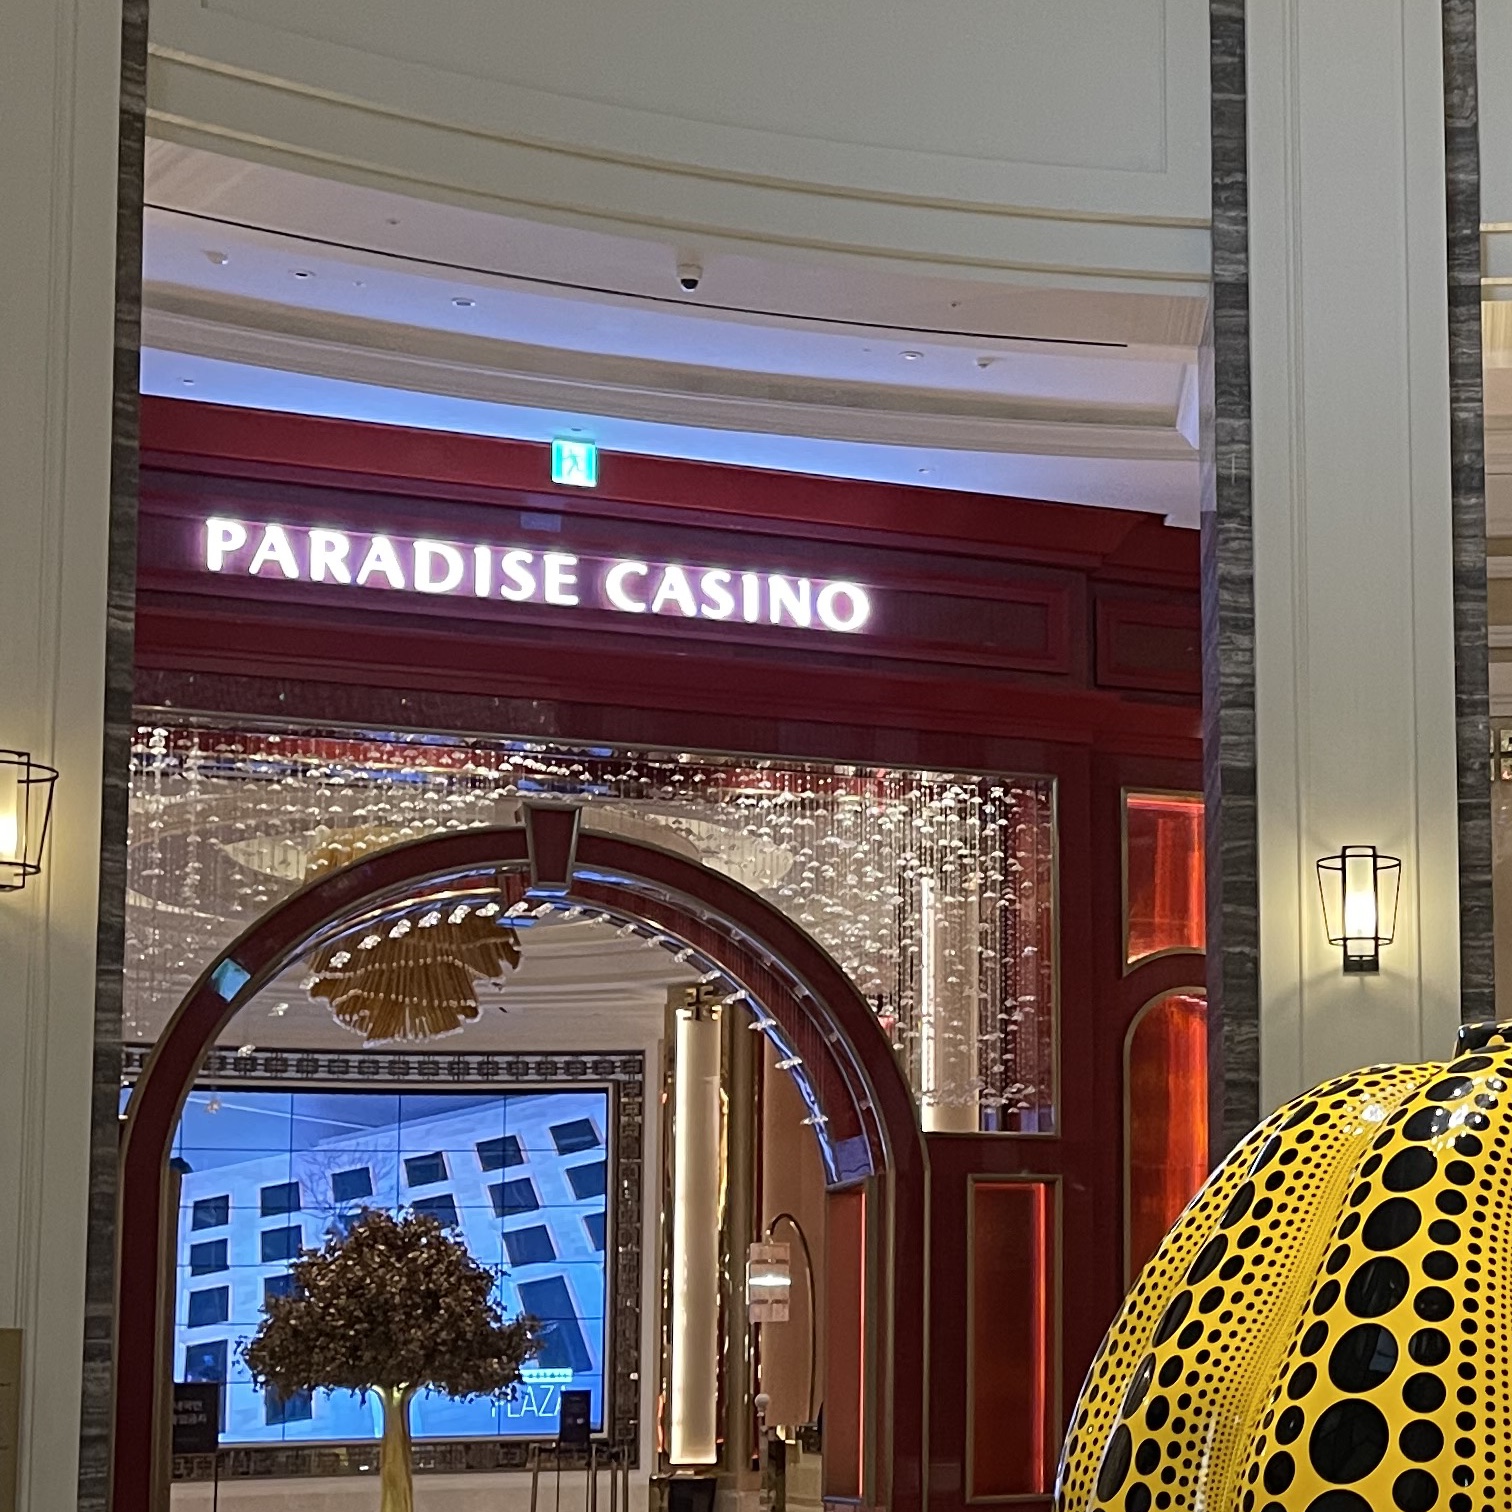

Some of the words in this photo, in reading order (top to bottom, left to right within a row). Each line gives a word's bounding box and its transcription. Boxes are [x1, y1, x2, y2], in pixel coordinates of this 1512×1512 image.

[205, 517, 580, 606] PARADISE
[604, 558, 872, 632] CASINO
[491, 1385, 566, 1417] LAZ
